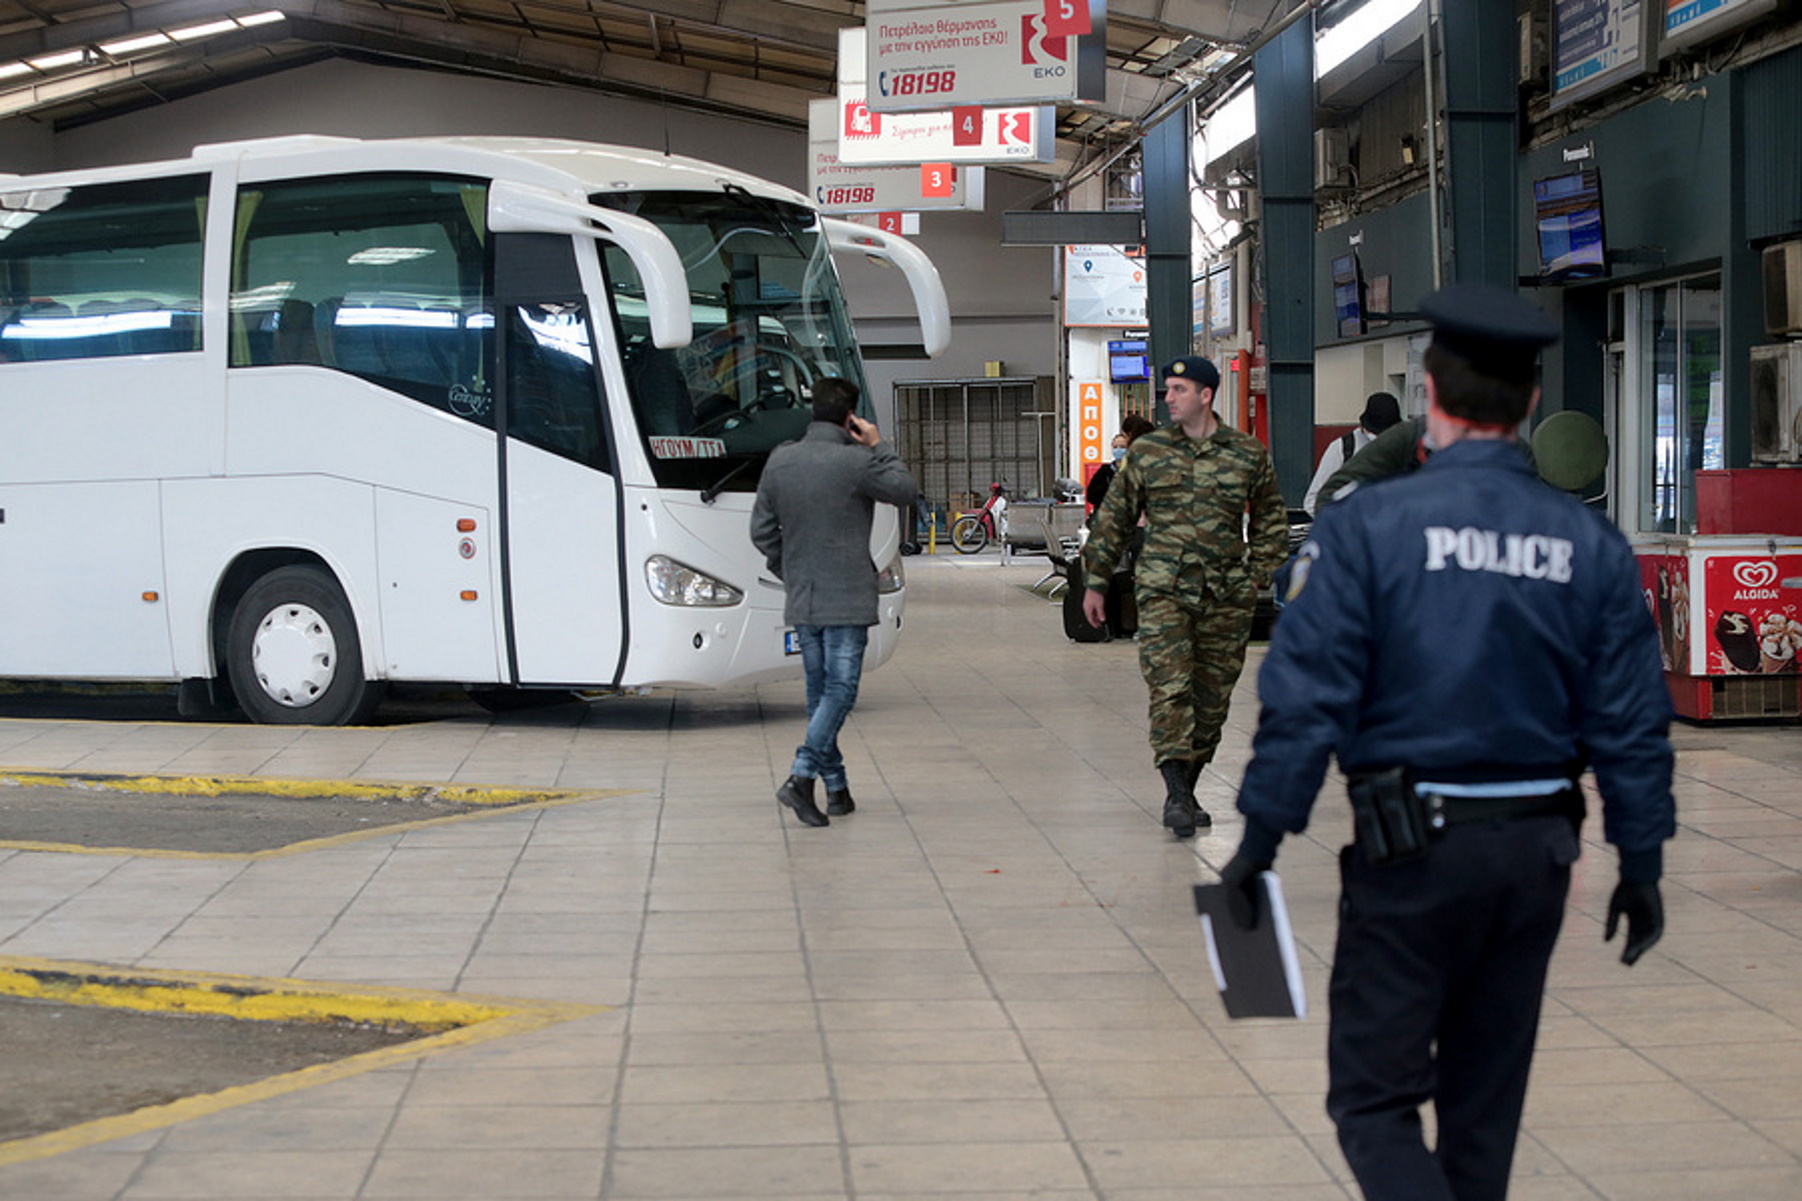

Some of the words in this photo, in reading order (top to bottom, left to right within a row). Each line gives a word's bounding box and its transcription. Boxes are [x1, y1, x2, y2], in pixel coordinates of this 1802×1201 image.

[1060, 0, 1074, 19] 5
[894, 41, 912, 52] την
[962, 36, 981, 47] της
[1033, 66, 1066, 79] EKO
[891, 70, 956, 96] 18198
[962, 115, 974, 134] 4
[930, 171, 942, 187] 3
[826, 187, 875, 204] 18198
[886, 217, 896, 231] 2
[1084, 386, 1099, 460] ΑΠΟΘ
[1423, 526, 1574, 584] POLICE
[1733, 589, 1779, 600] ALGIDA
